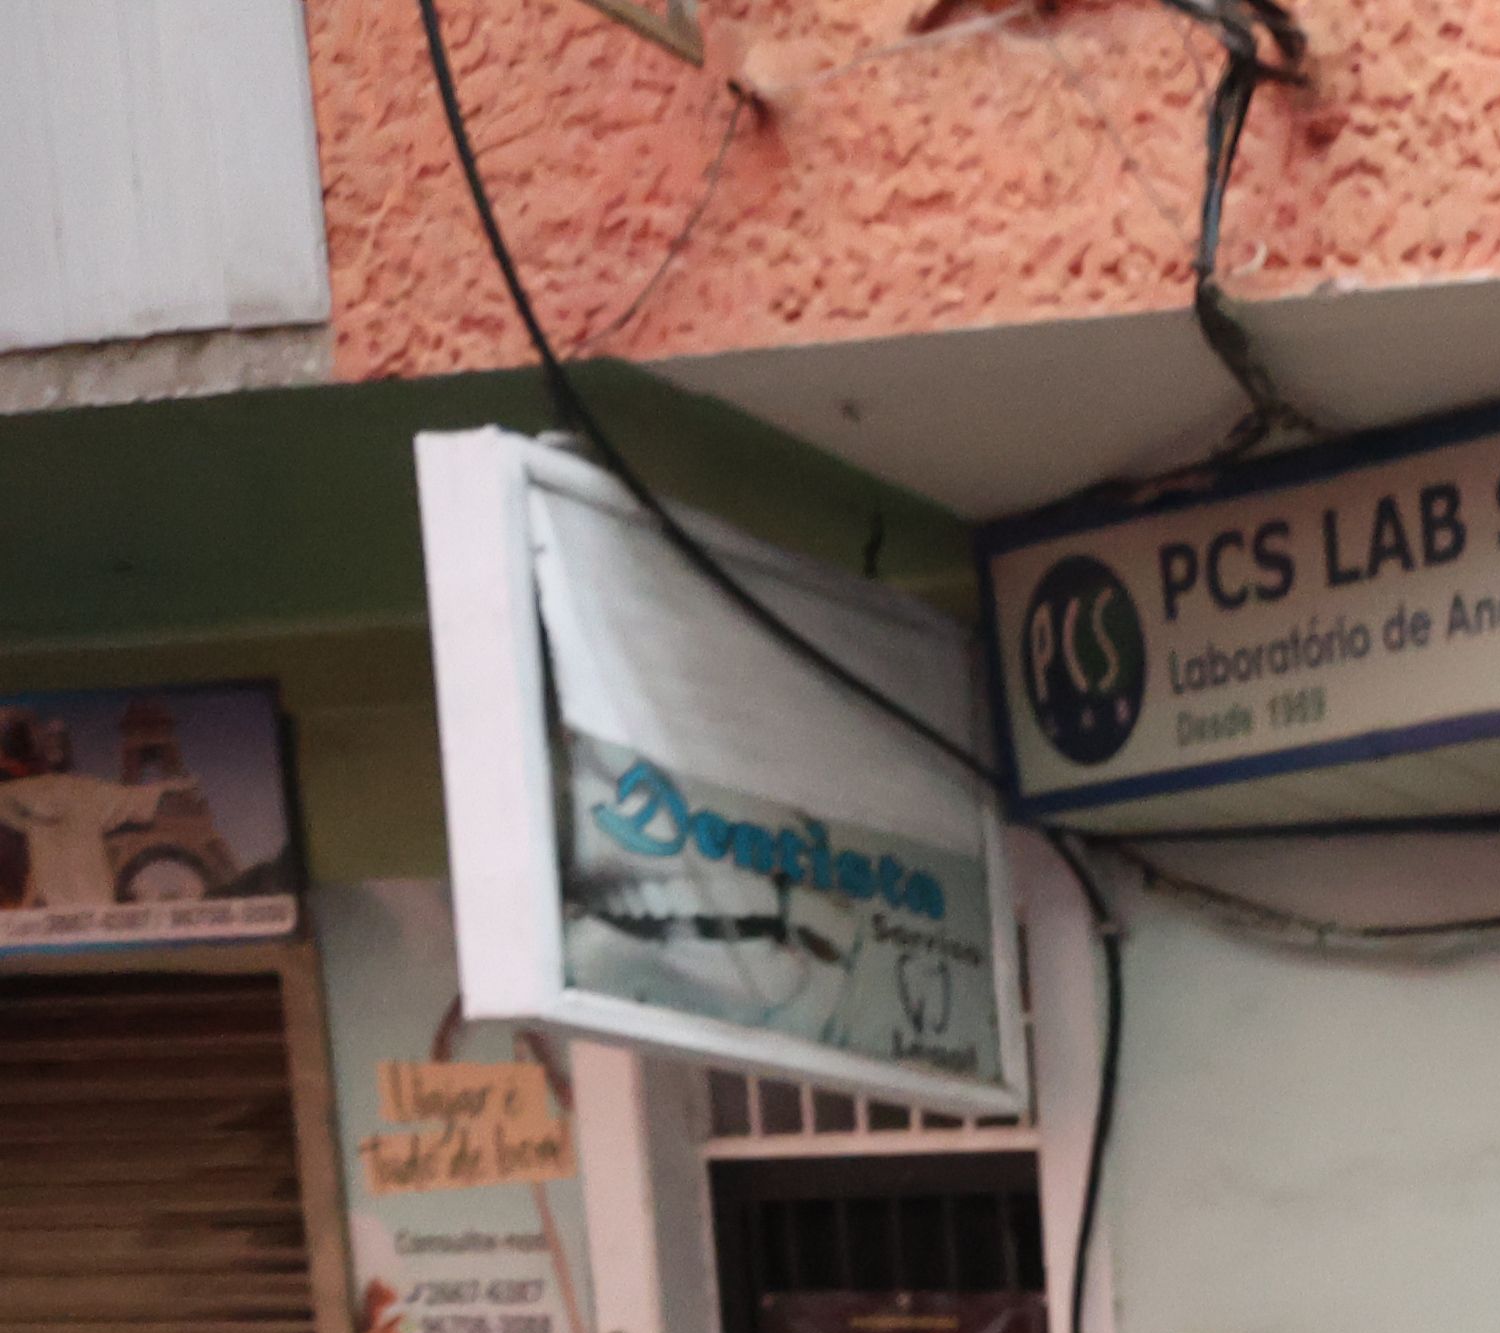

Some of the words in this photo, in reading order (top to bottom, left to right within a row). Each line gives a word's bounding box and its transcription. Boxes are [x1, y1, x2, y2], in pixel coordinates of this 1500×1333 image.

[1158, 520, 1295, 622] PCS
[1322, 482, 1467, 587] LAB
[1167, 616, 1372, 694] Laboratório
[1382, 605, 1432, 649] de
